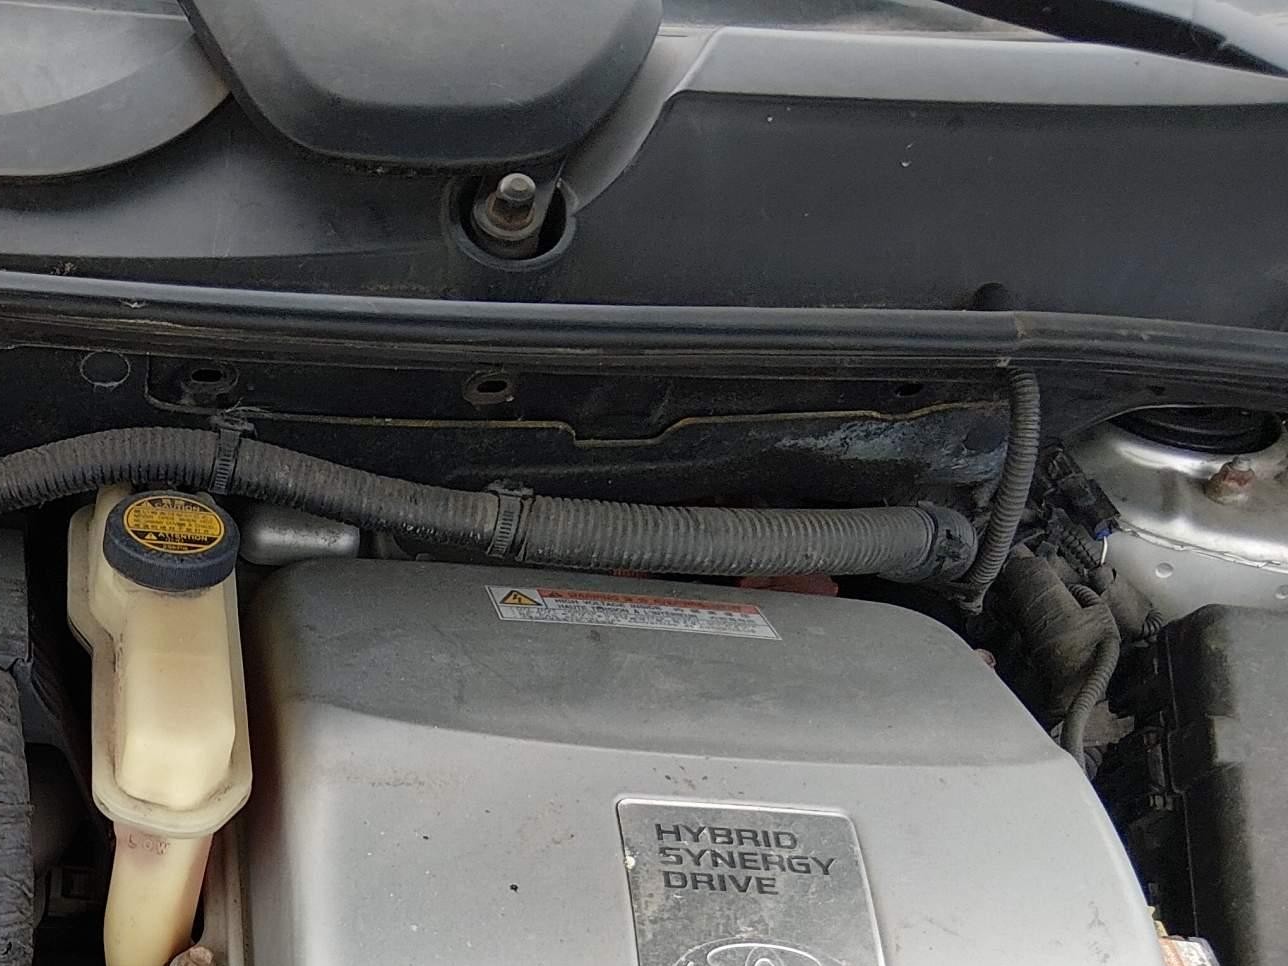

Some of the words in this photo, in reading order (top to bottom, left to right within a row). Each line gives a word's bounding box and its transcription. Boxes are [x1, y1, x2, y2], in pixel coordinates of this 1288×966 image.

[155, 502, 200, 512] CAUTION
[158, 532, 208, 542] ATTENTION
[128, 832, 169, 857] LOW
[655, 823, 798, 850] HYBRID
[658, 846, 837, 876] SYNERGY
[662, 870, 779, 895] DRIVE
